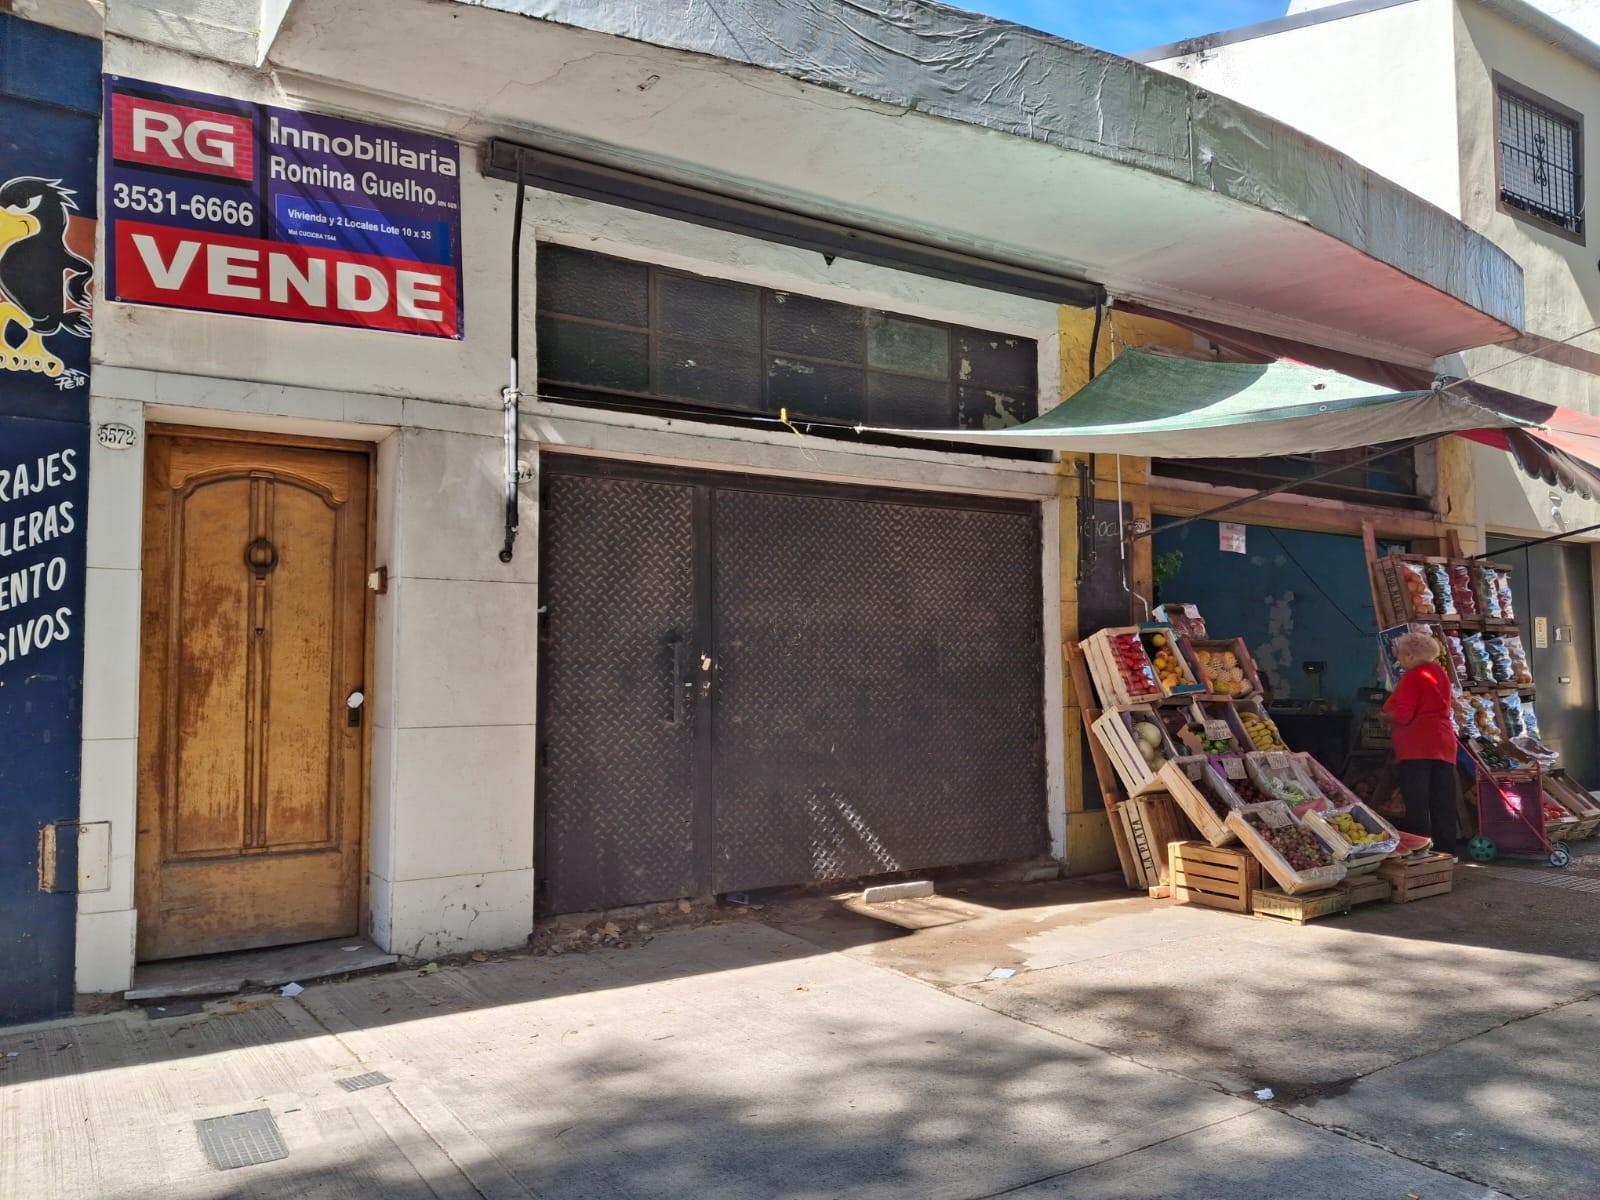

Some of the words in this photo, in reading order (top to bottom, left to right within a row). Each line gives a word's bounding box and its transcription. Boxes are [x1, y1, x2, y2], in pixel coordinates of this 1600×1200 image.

[132, 107, 235, 168] RG
[269, 116, 457, 177] Inmobiliaria
[113, 182, 255, 228] 3531-6666
[270, 155, 355, 193] Romina
[361, 171, 437, 206] Guelho
[287, 208, 328, 224] Vivienda
[329, 216, 335, 227] y
[336, 216, 344, 226] 2
[344, 217, 379, 232] Locales
[380, 223, 400, 236] Lote
[402, 226, 412, 237] 10
[420, 229, 432, 241] 35
[131, 233, 444, 323] VENDE
[99, 426, 134, 446] 5572
